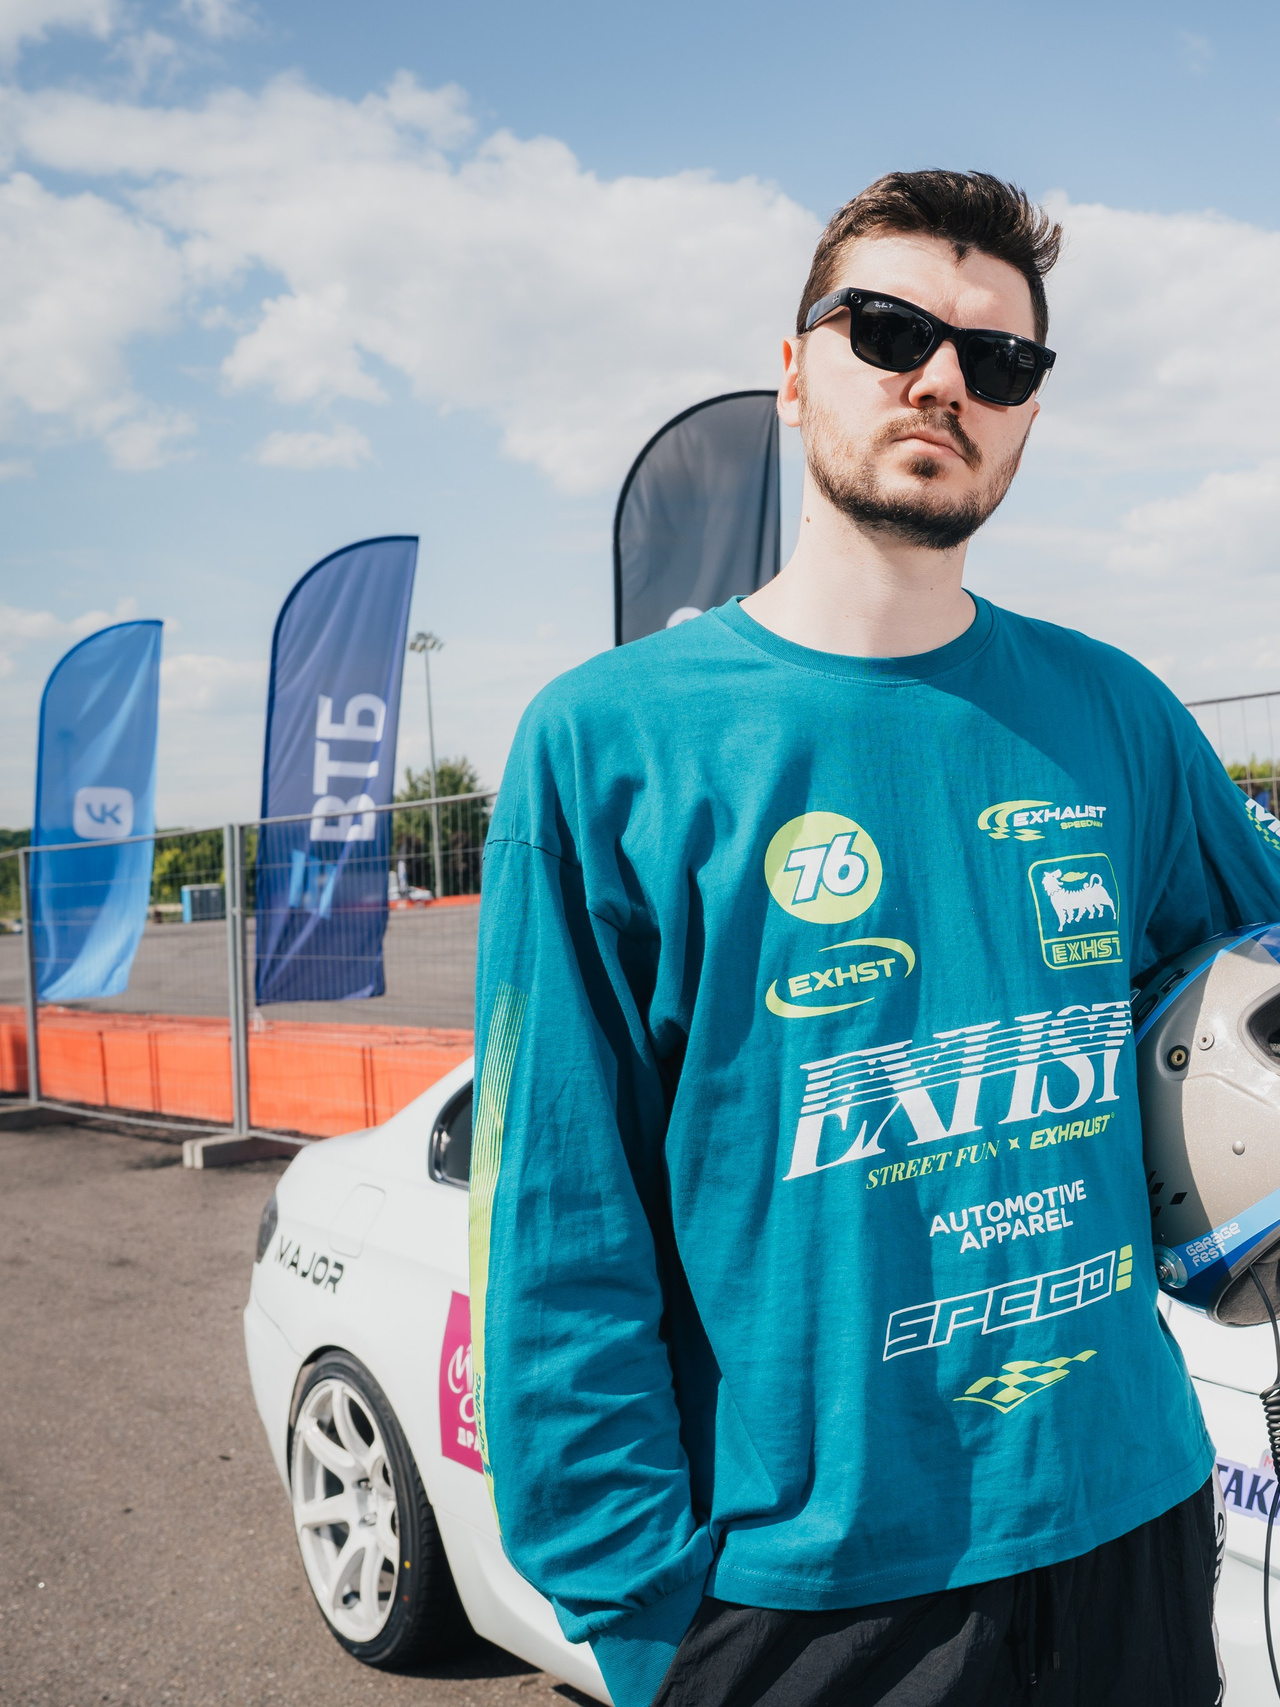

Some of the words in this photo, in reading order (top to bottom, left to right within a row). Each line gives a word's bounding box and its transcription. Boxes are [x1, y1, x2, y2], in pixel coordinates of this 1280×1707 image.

[309, 692, 388, 843] ВТБ
[84, 802, 122, 826] VK
[1013, 804, 1107, 828] EXHAUST
[784, 831, 869, 906] 76
[1051, 936, 1122, 965] EXHST
[788, 957, 896, 998] EXHST
[866, 1150, 953, 1190] STREET
[954, 1139, 1000, 1168] FUN
[929, 1179, 1087, 1237] AUTOMOTIVE
[959, 1207, 1074, 1253] APPAREL
[274, 1234, 345, 1294] MAJOR
